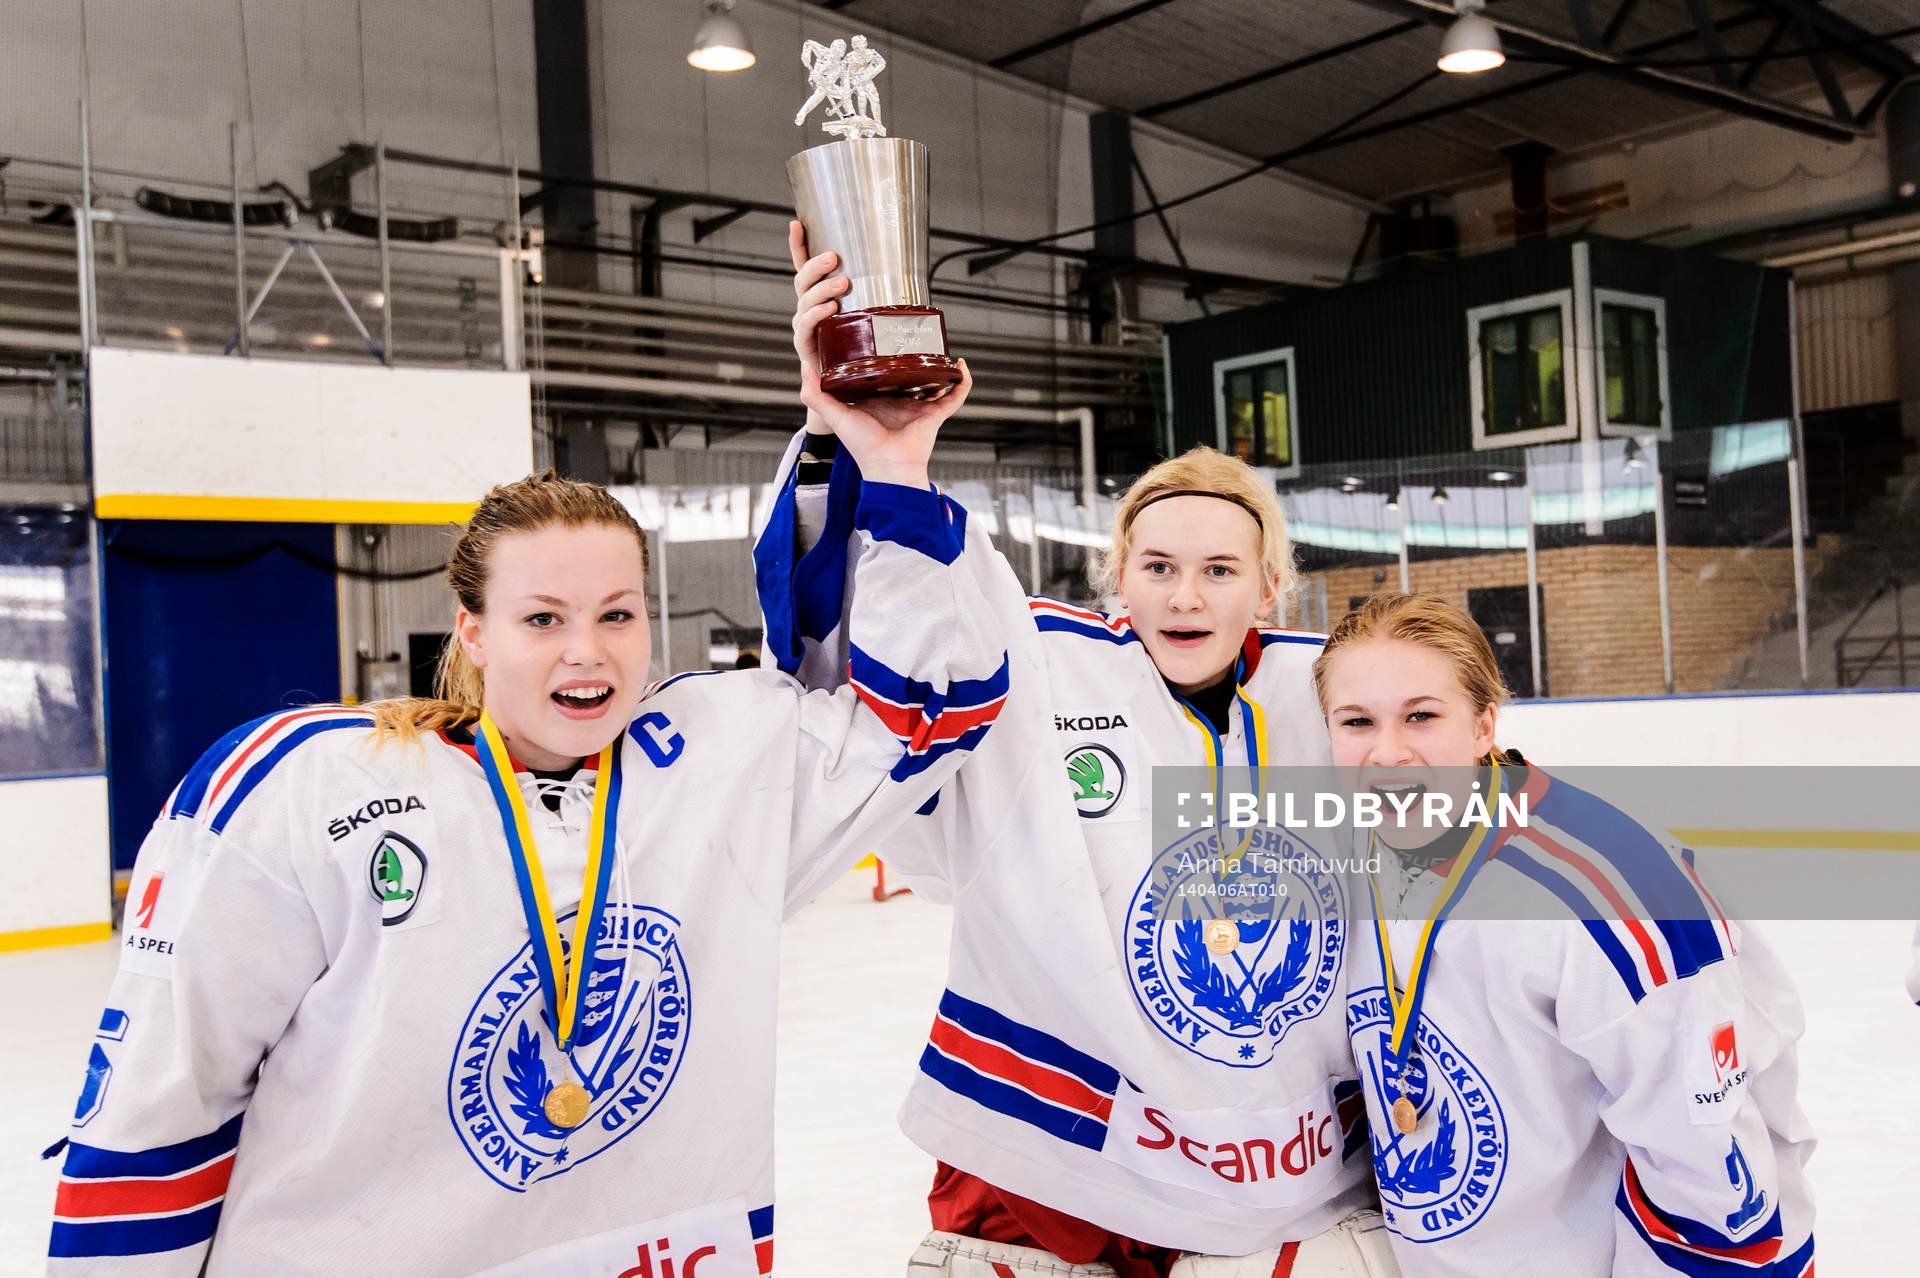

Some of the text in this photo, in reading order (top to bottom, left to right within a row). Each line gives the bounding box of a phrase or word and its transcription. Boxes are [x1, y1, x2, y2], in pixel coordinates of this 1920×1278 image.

[628, 711, 686, 768] C
[328, 795, 426, 842] ŠKODA
[1136, 1107, 1333, 1184] Scandic
